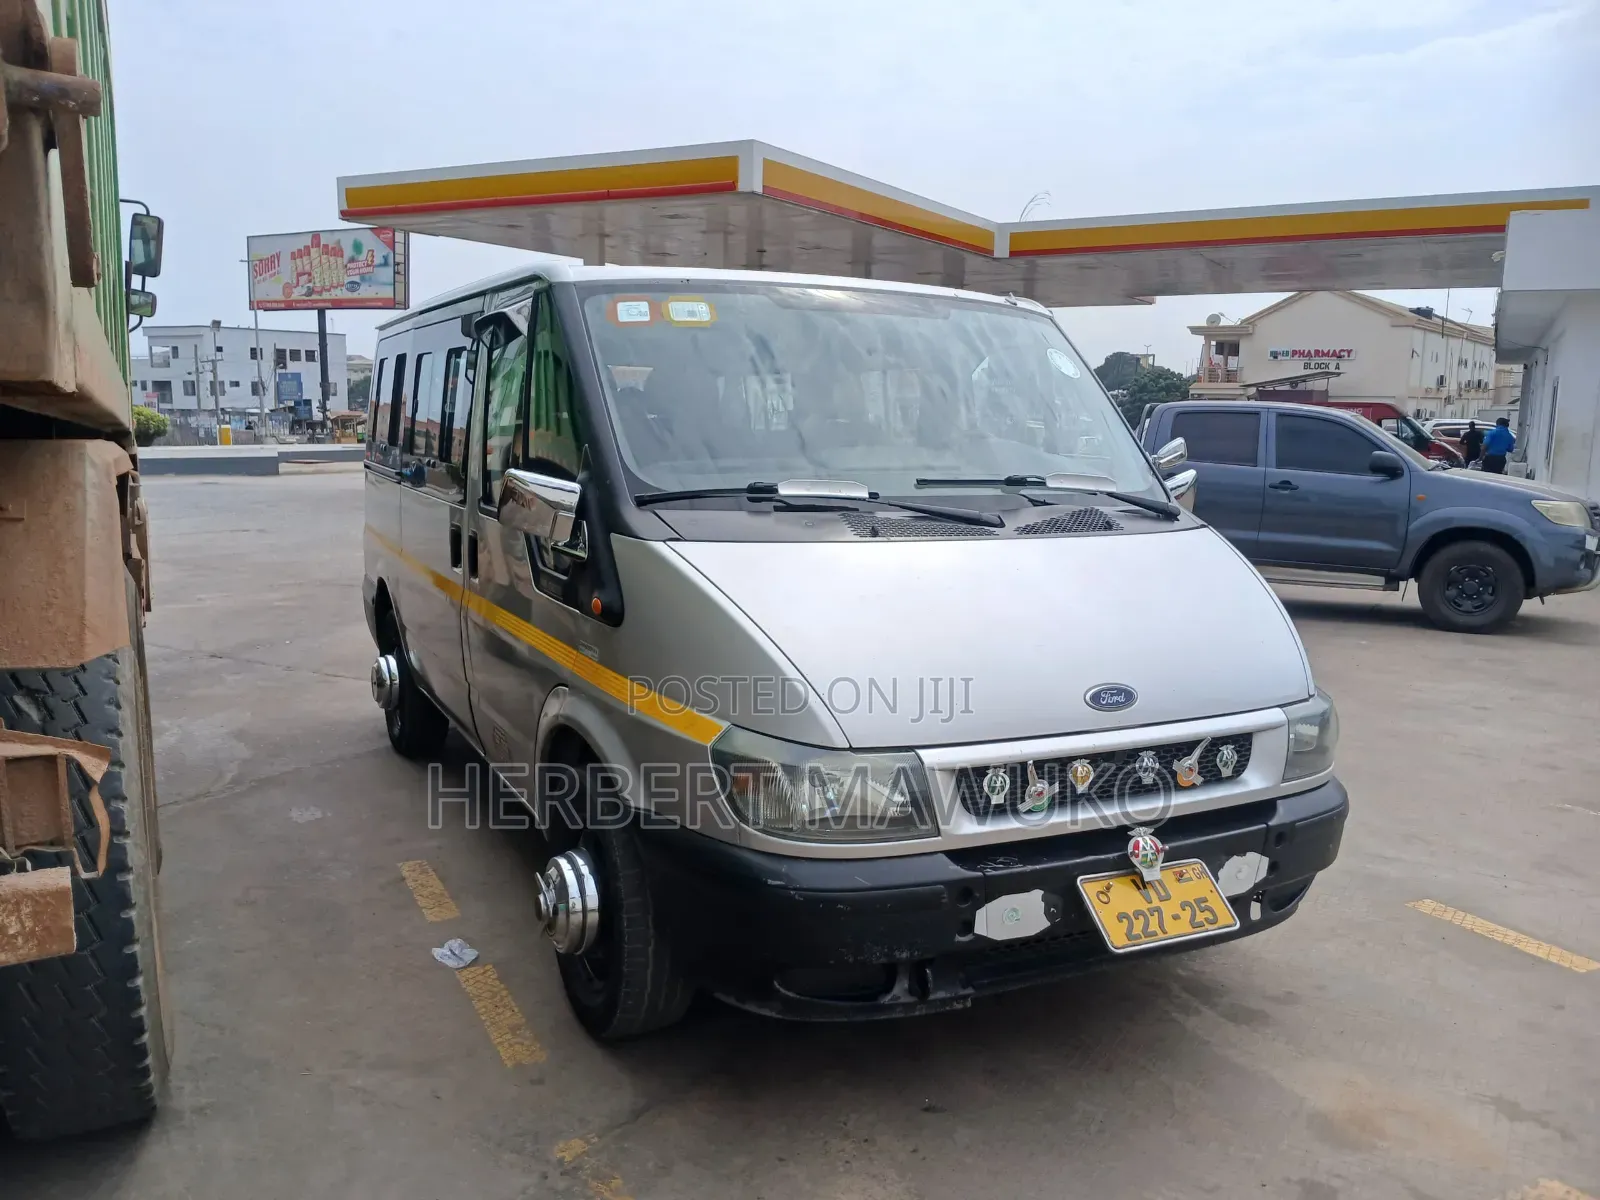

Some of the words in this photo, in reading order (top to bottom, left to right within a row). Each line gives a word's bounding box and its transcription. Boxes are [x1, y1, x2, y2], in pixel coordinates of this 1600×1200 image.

[253, 250, 281, 279] SORRY
[1291, 349, 1353, 358] PHARMACY
[1303, 362, 1330, 370] BLOCK
[1334, 362, 1341, 370] A
[1100, 690, 1126, 704] Ford
[1116, 897, 1219, 942] 227-25
